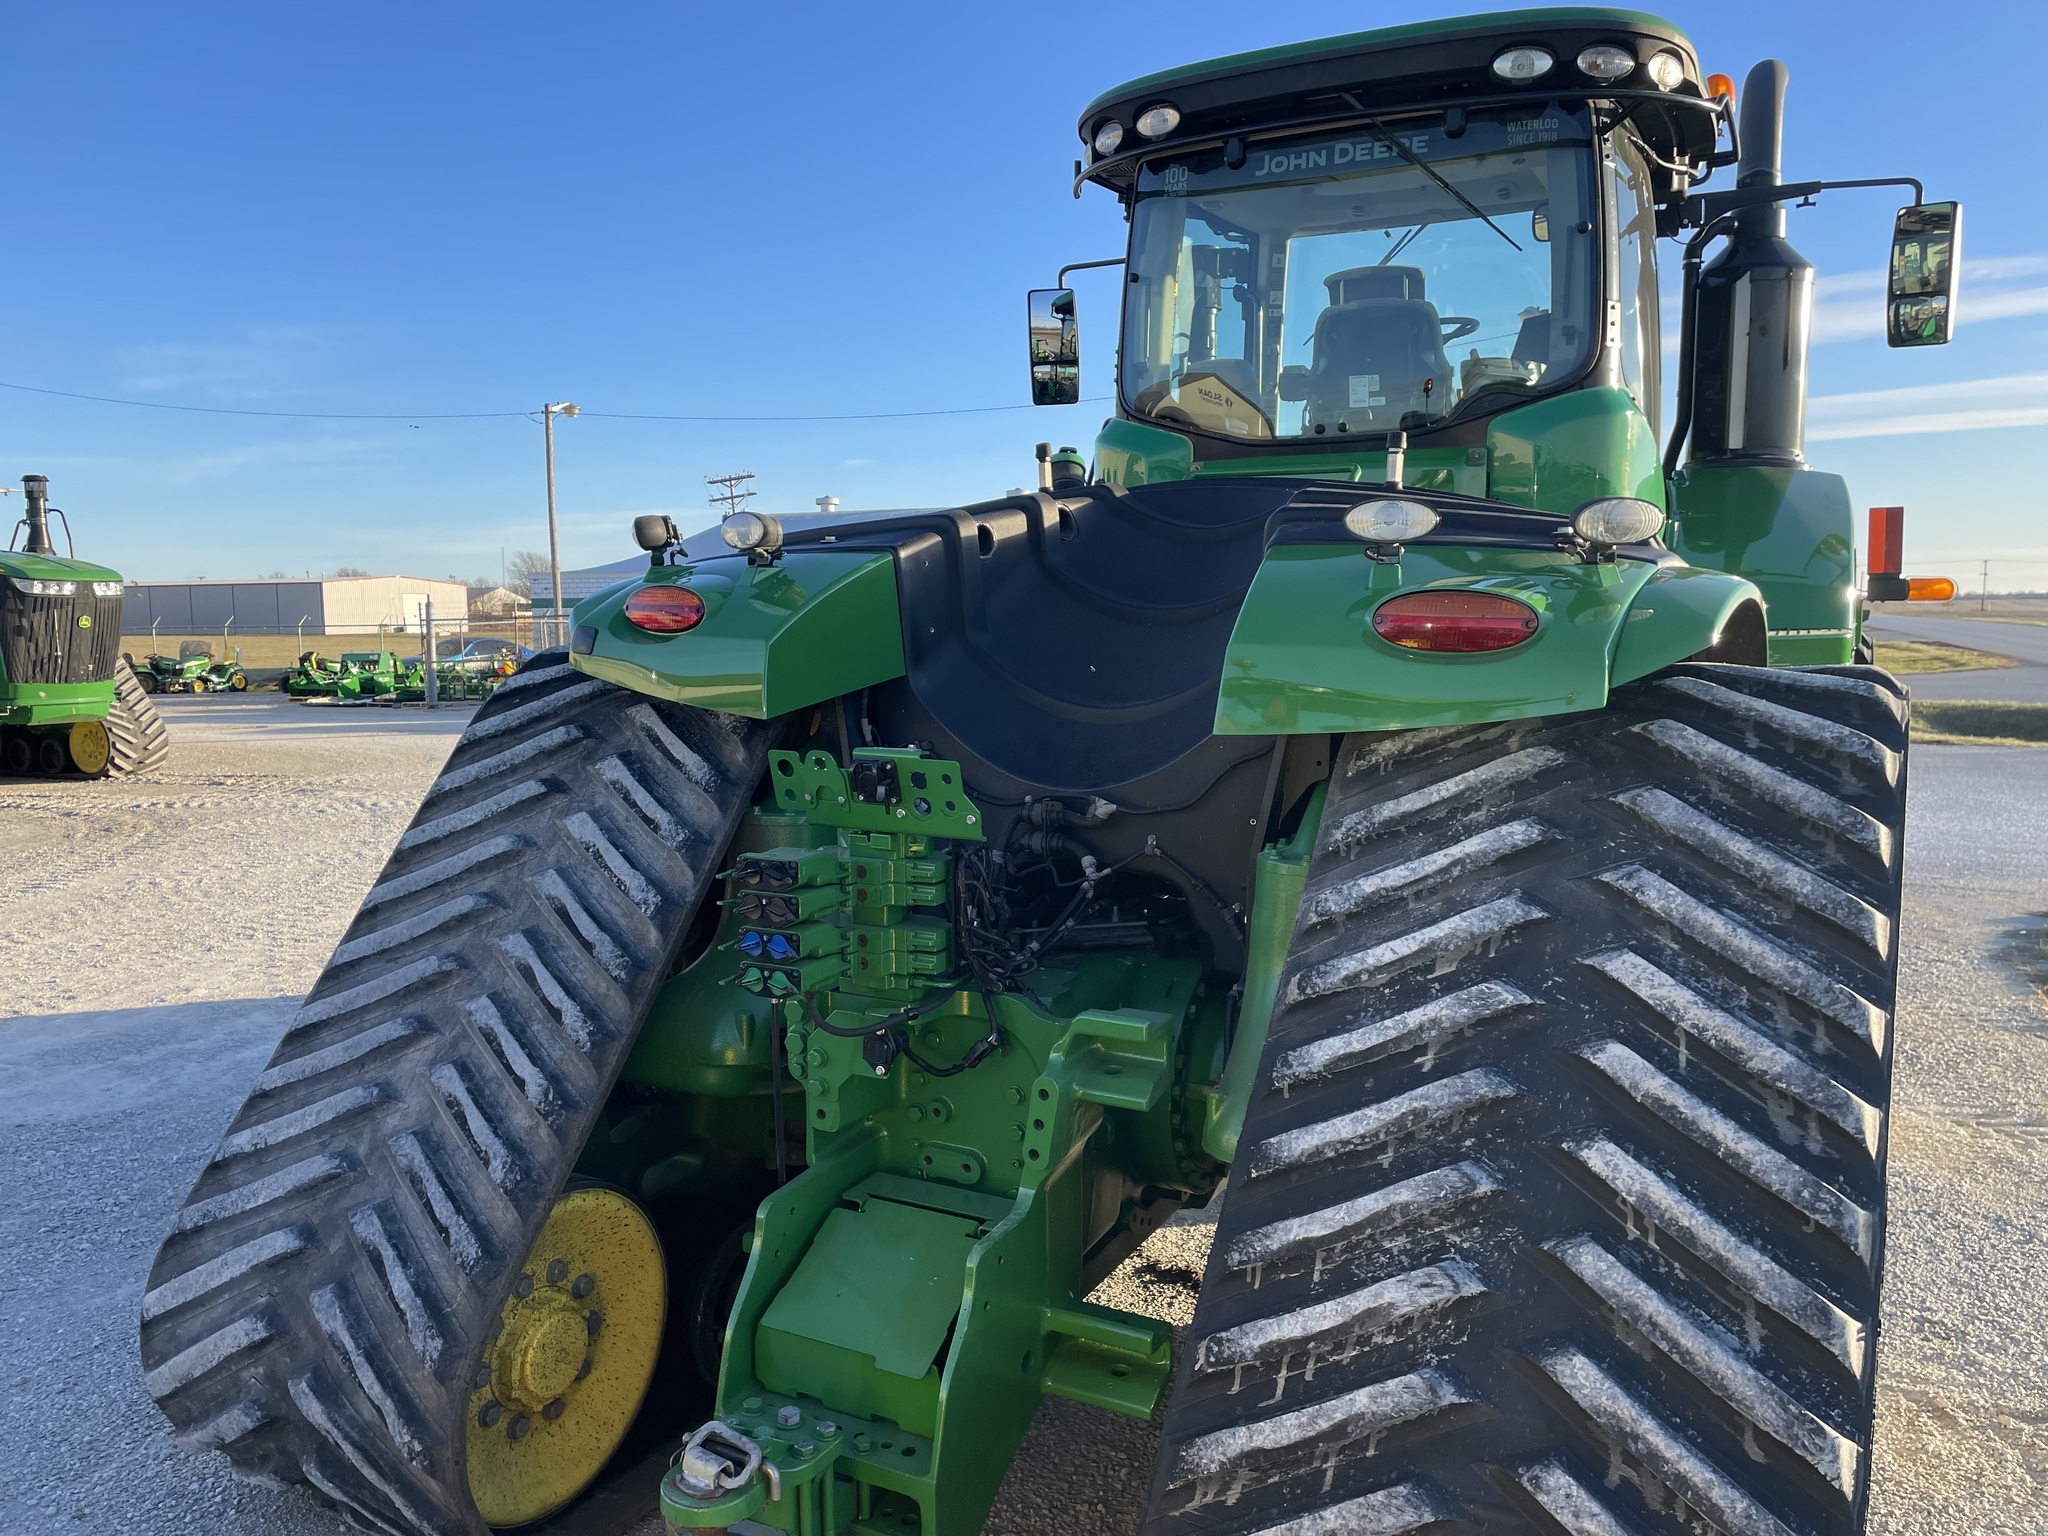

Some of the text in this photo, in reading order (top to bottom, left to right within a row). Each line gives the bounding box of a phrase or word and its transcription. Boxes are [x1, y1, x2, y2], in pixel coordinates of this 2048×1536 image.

[1507, 118, 1558, 132] WATERLOO
[1507, 131, 1557, 145] SINCE 1918
[1255, 149, 1327, 176] JOHN
[1165, 166, 1188, 184] 100
[1164, 181, 1188, 193] YEARS
